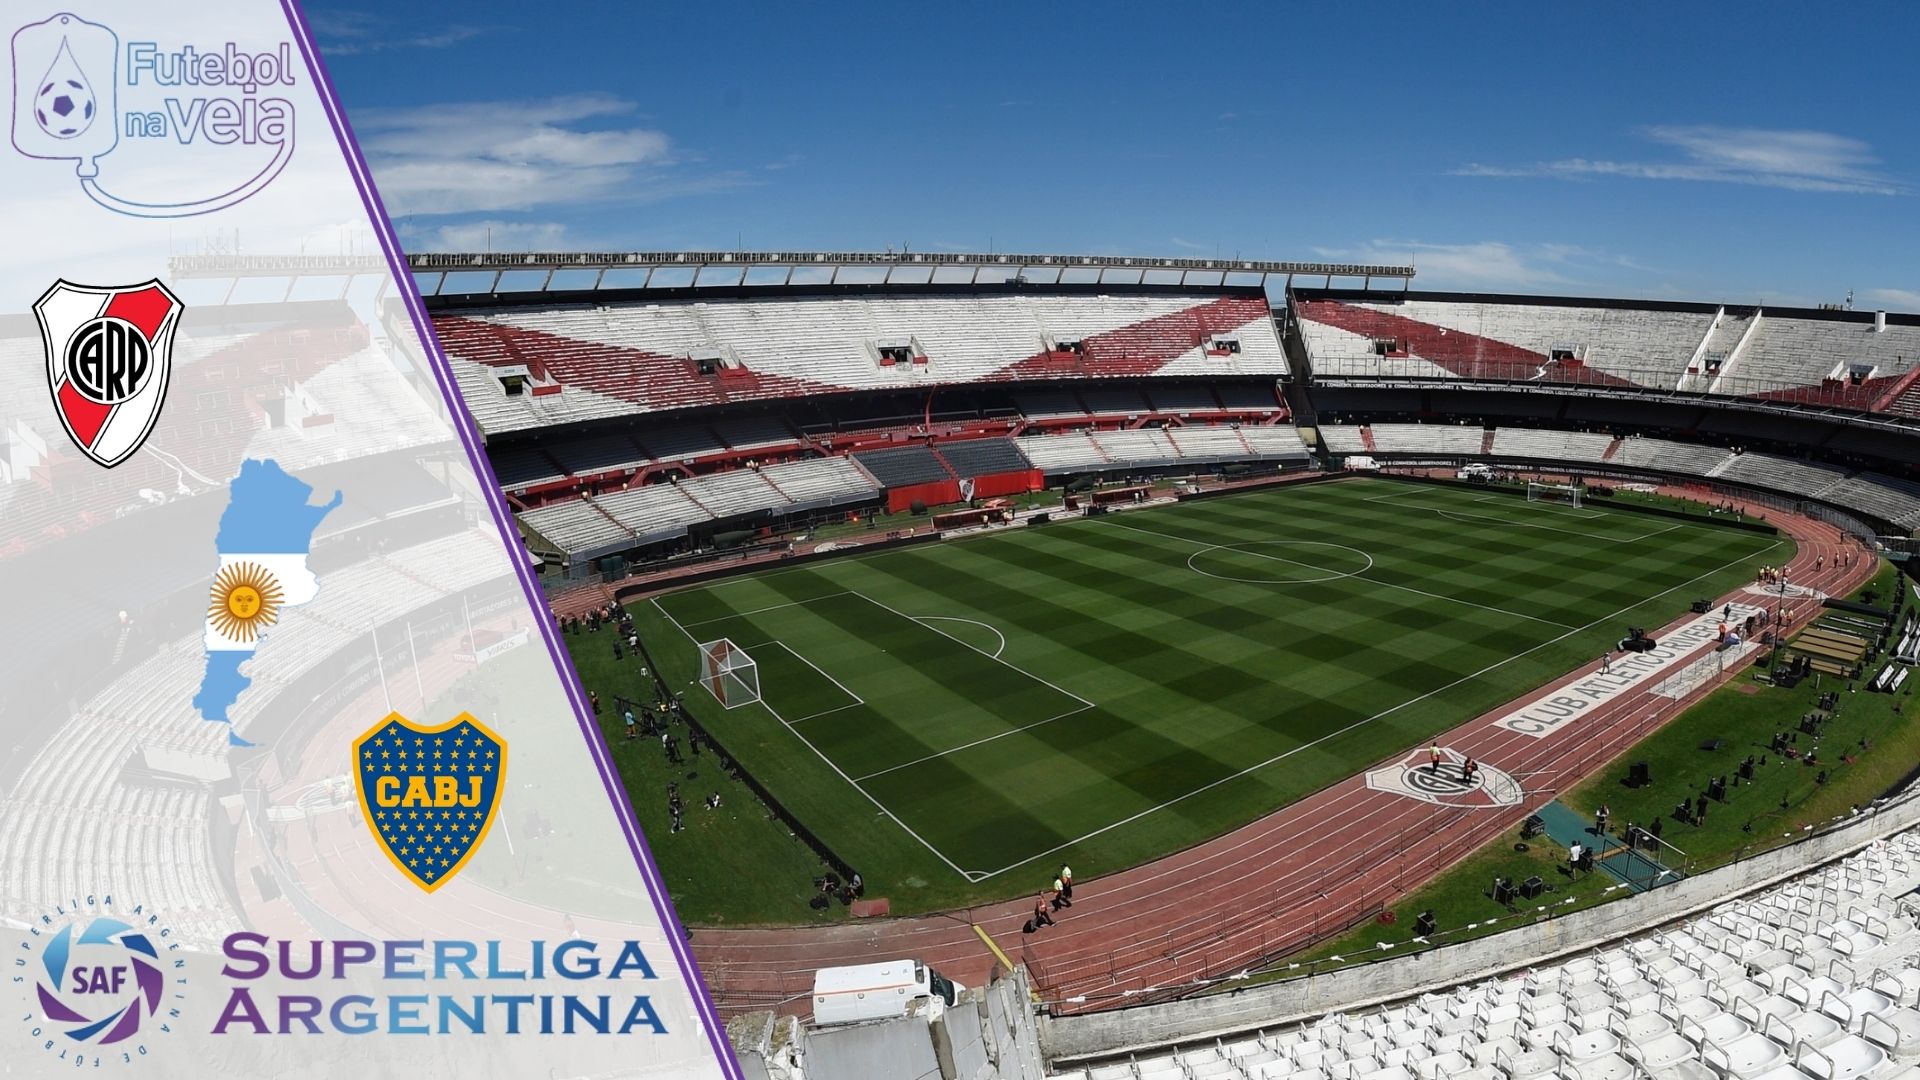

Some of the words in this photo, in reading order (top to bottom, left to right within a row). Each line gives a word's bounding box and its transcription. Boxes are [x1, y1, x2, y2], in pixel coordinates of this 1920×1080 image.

[1507, 696, 1589, 733] CLUB
[1574, 649, 1675, 699] ATLETICO
[1658, 624, 1719, 651] RIVER
